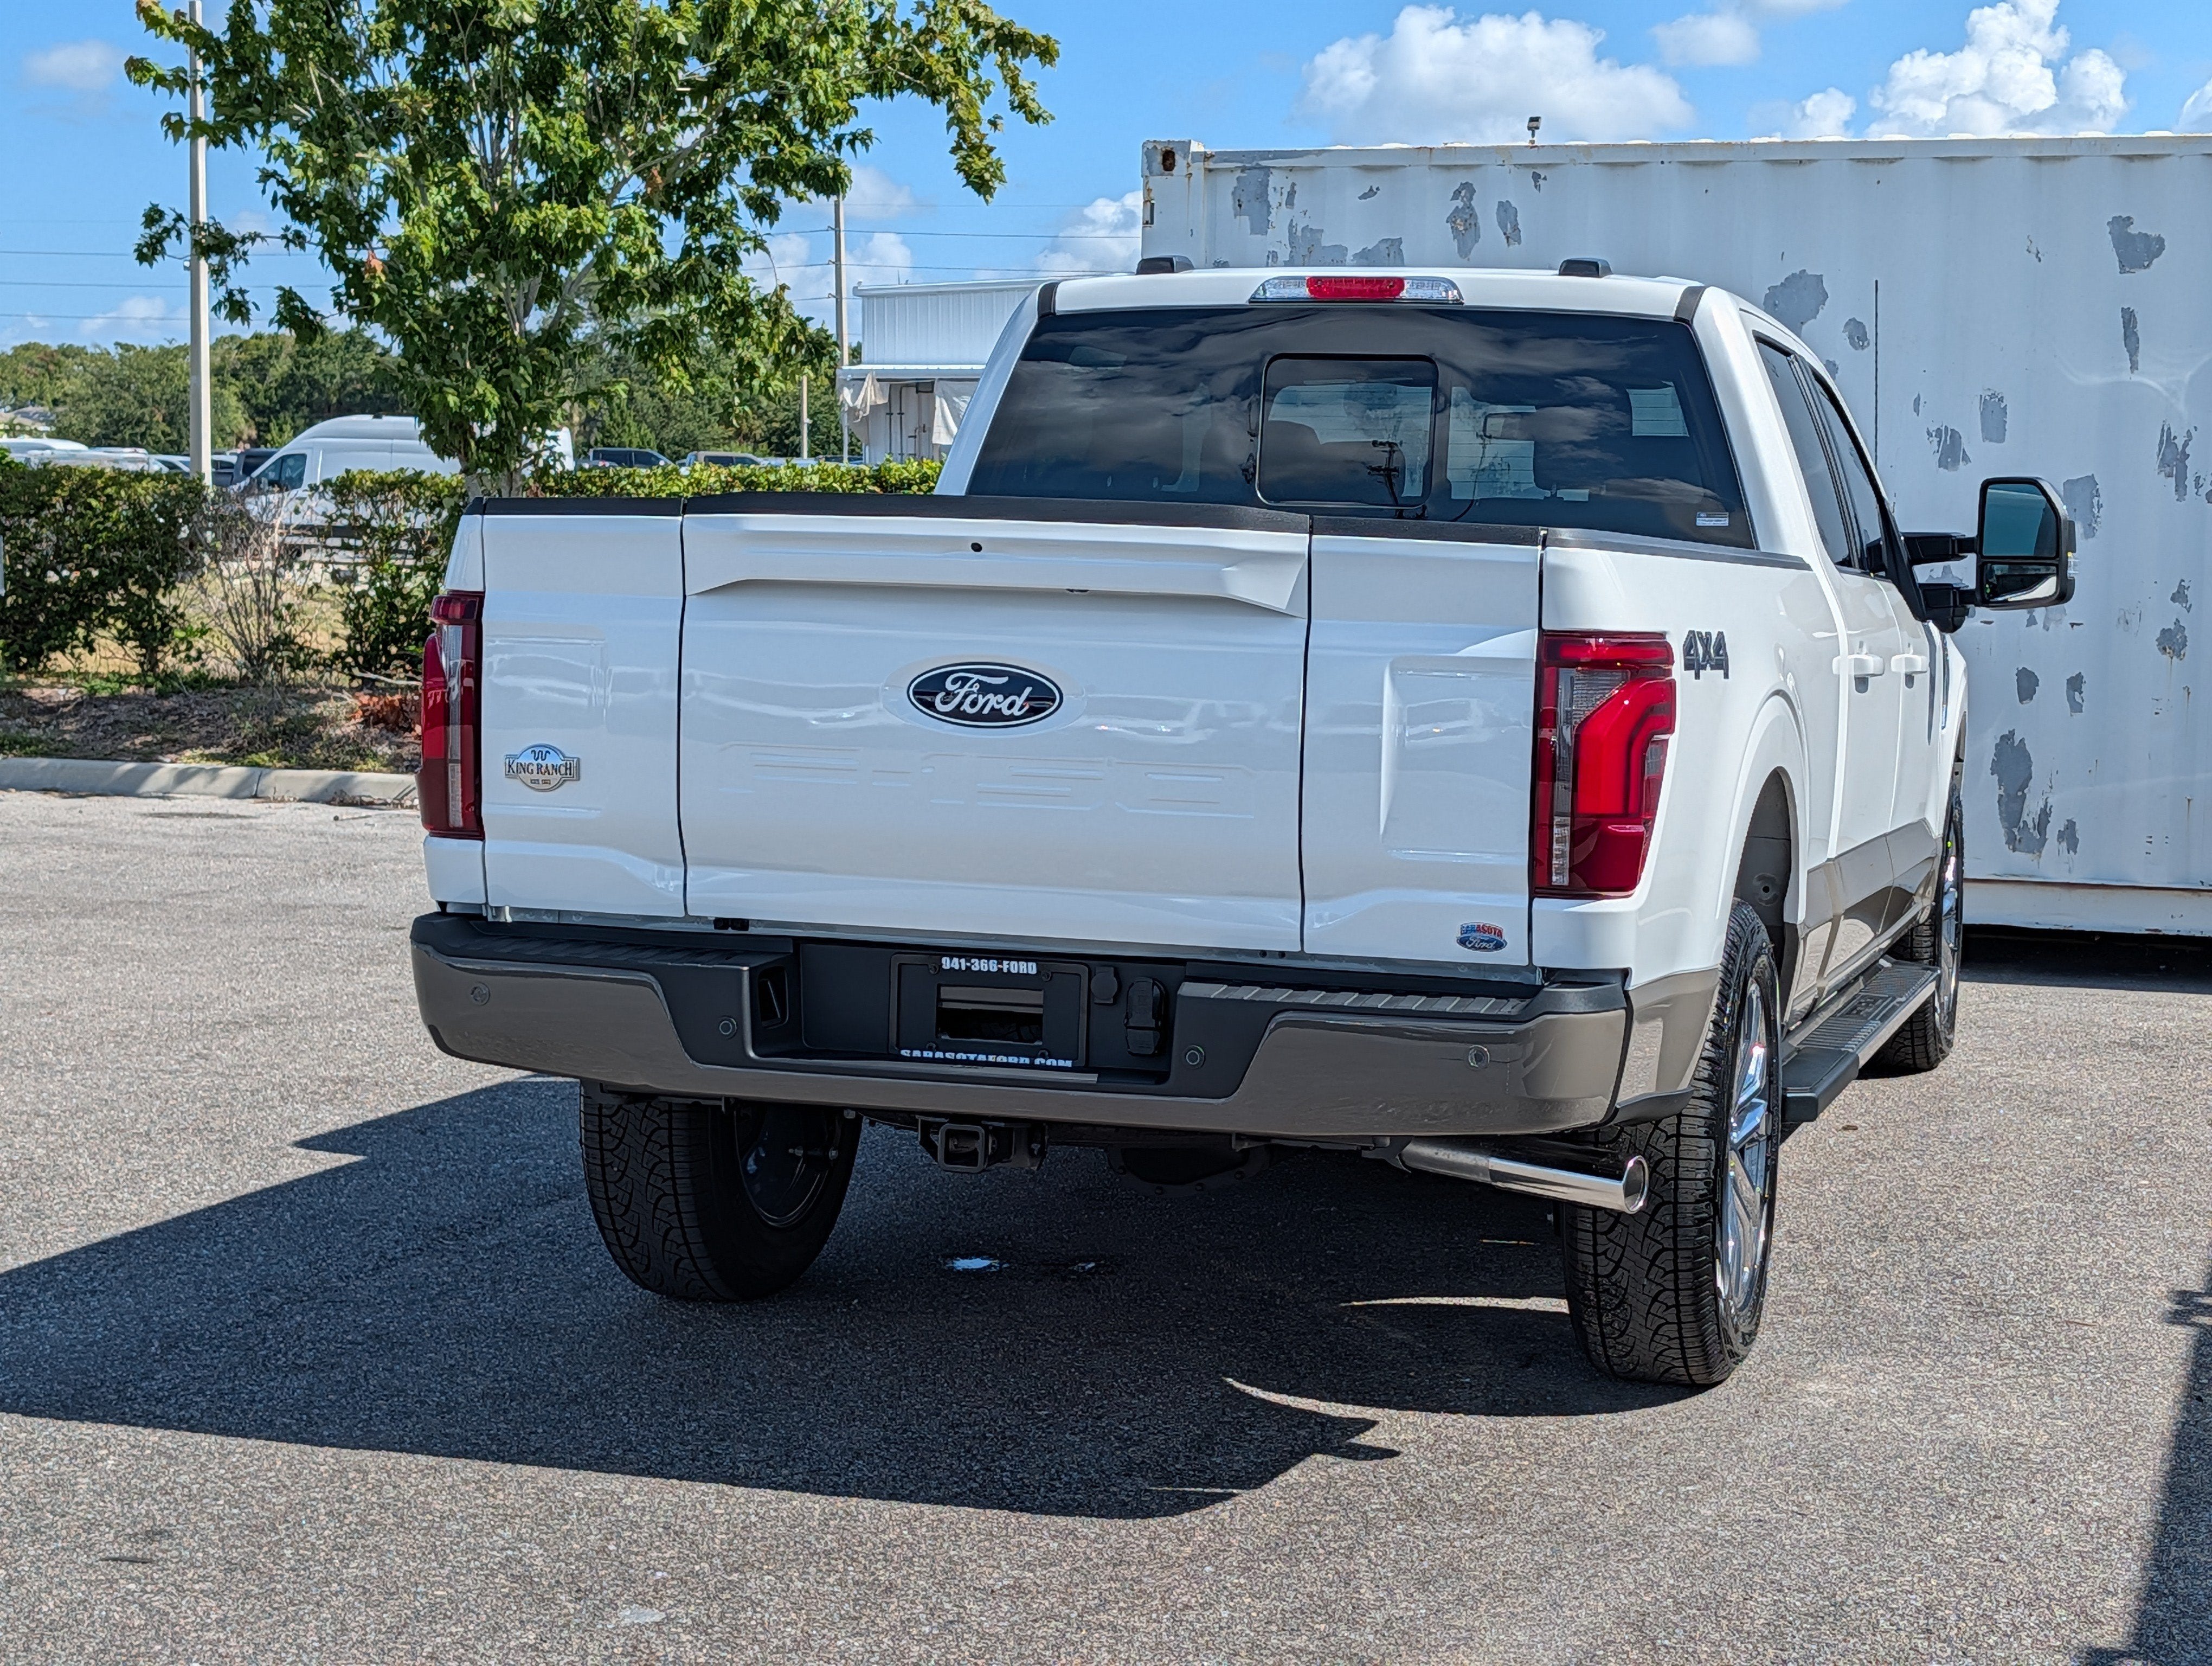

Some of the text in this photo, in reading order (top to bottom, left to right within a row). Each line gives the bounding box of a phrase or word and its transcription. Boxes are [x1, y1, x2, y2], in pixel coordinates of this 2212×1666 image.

[934, 672, 1033, 716] Ford
[507, 758, 572, 776] KING RANCH
[1465, 935, 1496, 949] Ford
[941, 957, 1037, 975] 941-366-FORD
[900, 1049, 1072, 1067] SARASOTAFORDCOM
